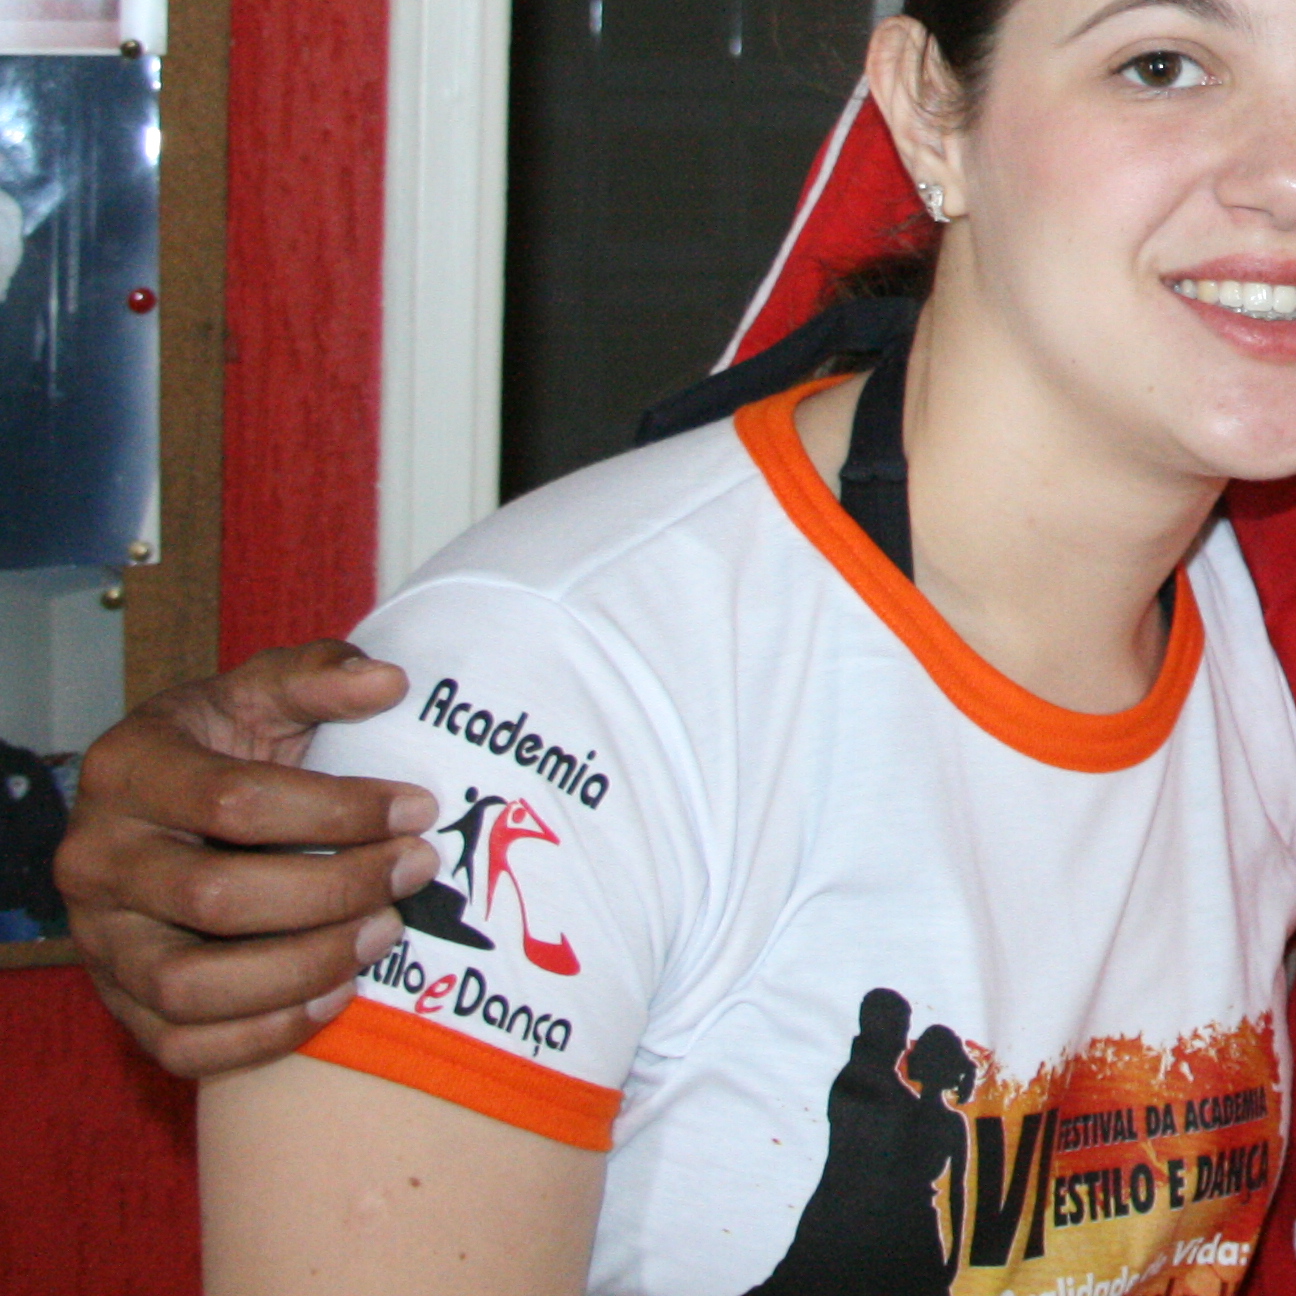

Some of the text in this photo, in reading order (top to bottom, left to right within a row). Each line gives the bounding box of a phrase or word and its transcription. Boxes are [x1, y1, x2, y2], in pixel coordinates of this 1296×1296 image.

[418, 677, 611, 810] Academia
[415, 972, 459, 1015] e
[453, 966, 574, 1058] Dança
[1146, 1103, 1179, 1140] DA
[1185, 1086, 1269, 1135] ACADEMIA
[1053, 1162, 1156, 1229] ESTILO
[1167, 1158, 1186, 1212] E
